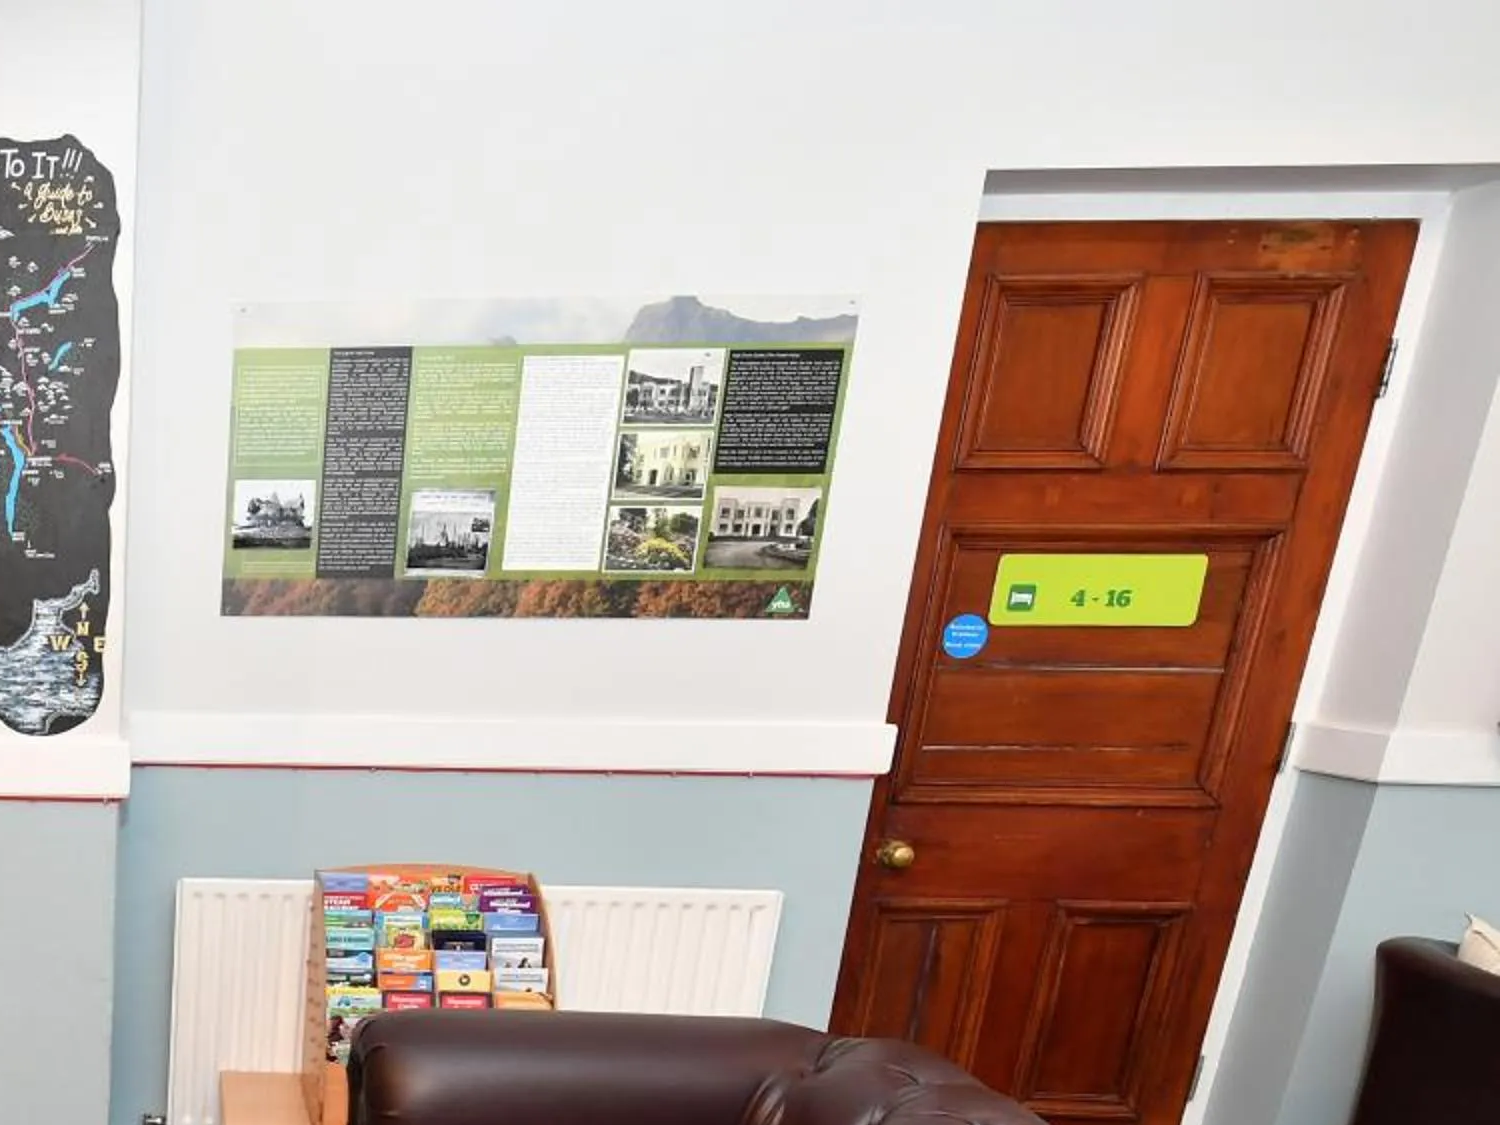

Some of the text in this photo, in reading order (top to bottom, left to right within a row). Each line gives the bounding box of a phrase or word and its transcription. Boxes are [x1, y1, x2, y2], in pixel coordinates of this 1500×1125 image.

[1069, 589, 1087, 608] 4
[1104, 589, 1133, 608] 16
[76, 621, 90, 636] N
[49, 635, 106, 652] W E
